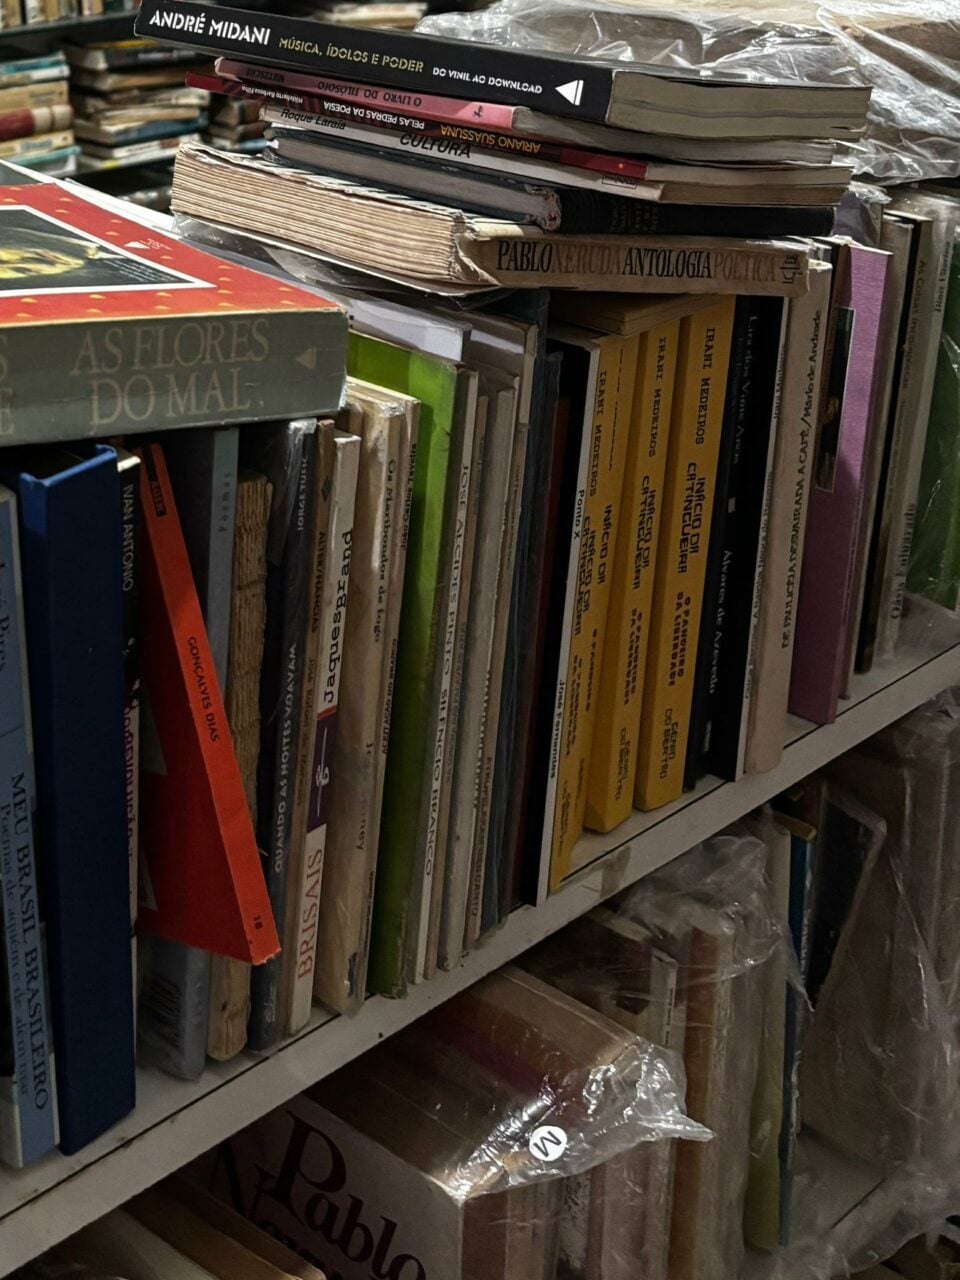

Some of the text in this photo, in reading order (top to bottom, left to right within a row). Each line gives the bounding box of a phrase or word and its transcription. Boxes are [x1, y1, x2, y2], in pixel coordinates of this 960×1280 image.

[149, 8, 271, 46] ANDRÉ MIDANI
[279, 35, 425, 73] MÚSICA, ÍDOLOS E PODER
[363, 88, 378, 99] DO
[384, 92, 412, 106] LIVRO
[432, 66, 543, 95] DO VINIL AO DOWNLOAD
[280, 107, 347, 131] Roque Laraia
[323, 100, 425, 130] PELAS PEDRAS DA POESIA
[440, 123, 541, 154] ARIANO SUASSUNA
[399, 131, 473, 159] CULTURA
[496, 239, 553, 272] PABLO
[621, 245, 713, 280] ANTOLOGIA
[70, 318, 271, 377] AS FLORES
[808, 310, 821, 363] Andrade
[89, 368, 252, 426] DO MAL
[648, 336, 667, 458] IRANI MEDEIROS
[694, 327, 716, 446] IRANI MEDEIROS
[589, 370, 607, 497] IRANI MEDEIROS
[296, 494, 306, 532] JORGE
[575, 489, 585, 527] Ponto
[632, 475, 650, 590] CATINGUEIRA
[677, 462, 697, 575] CATINGUEIRA
[121, 516, 135, 592] ANTONIO
[716, 607, 726, 626] de
[186, 636, 220, 743] GONÇALVES DIAS
[709, 630, 723, 694] Azevedo
[274, 642, 297, 873] QUANDO AS NOITES VOAVAM
[550, 680, 566, 780] José Fernandes
[0, 803, 12, 876] Poemas
[6, 879, 17, 901] de
[10, 771, 49, 1110] MEU BRASIL BRASILEIRO
[298, 847, 323, 979] BRISAIS
[254, 1109, 427, 1280] Pablo
